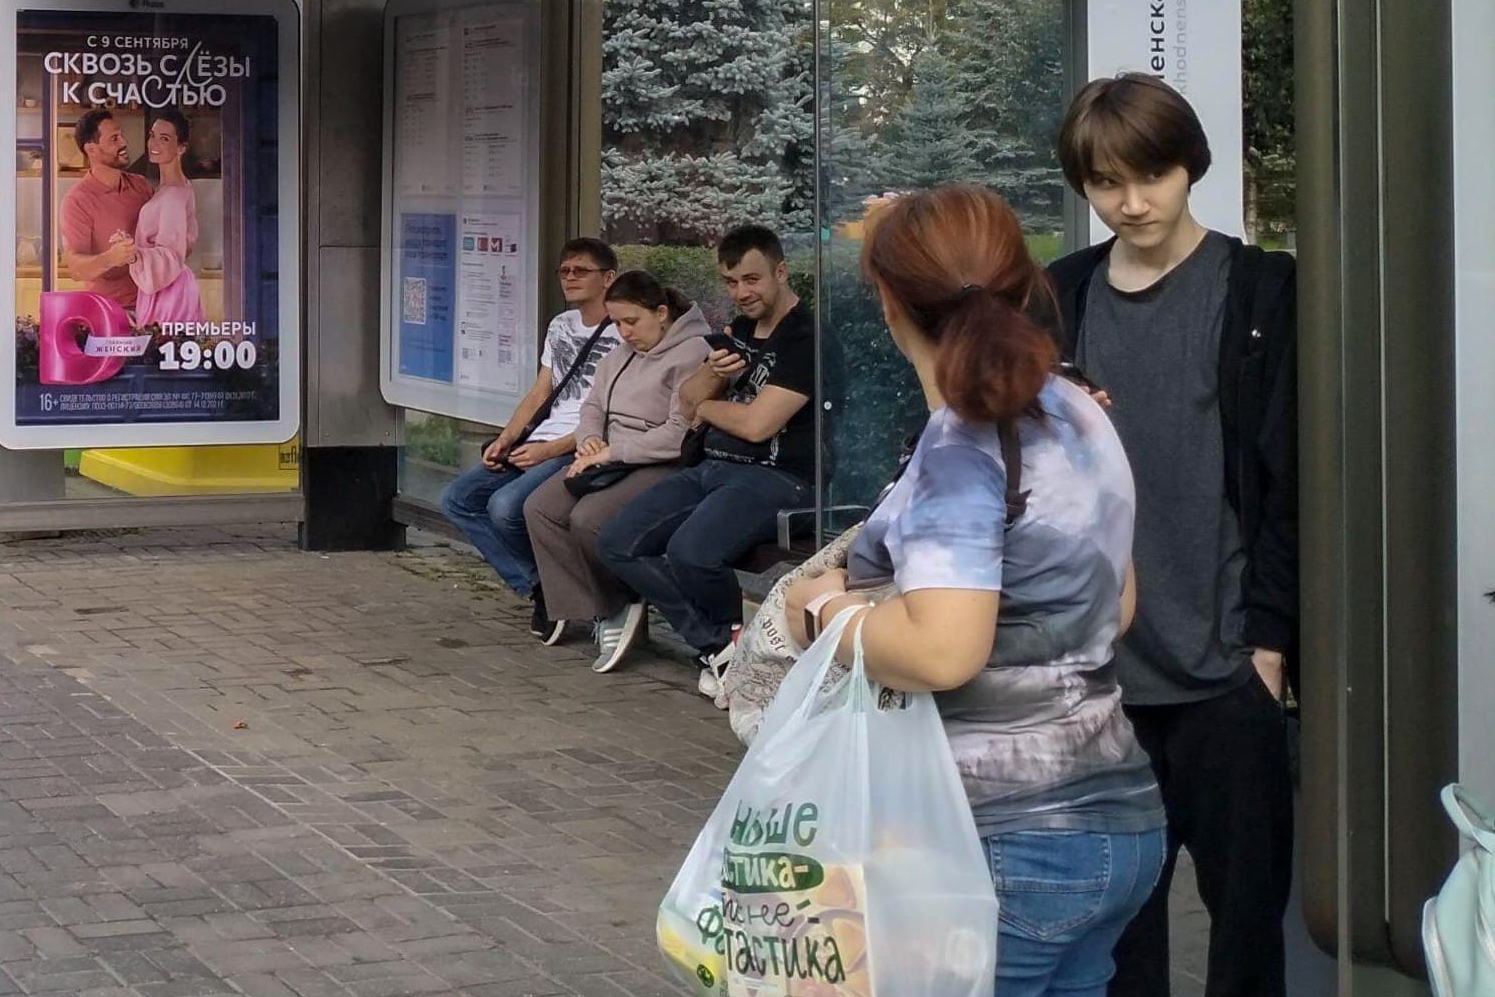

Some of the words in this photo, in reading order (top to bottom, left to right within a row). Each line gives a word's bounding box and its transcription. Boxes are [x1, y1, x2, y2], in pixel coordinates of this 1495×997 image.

[87, 35, 98, 48] С
[101, 35, 110, 48] 9
[114, 36, 188, 49] СЕНТЯБРЯ
[44, 51, 153, 76] СКВОЗЬ
[160, 41, 250, 87] СЛЁЗЫ
[63, 81, 80, 104] К
[88, 75, 227, 108] СЧАСТЬЮ
[161, 321, 256, 336] ПРЕМЬЕРЫ
[158, 340, 257, 371] 19:00
[39, 393, 59, 412] 16+
